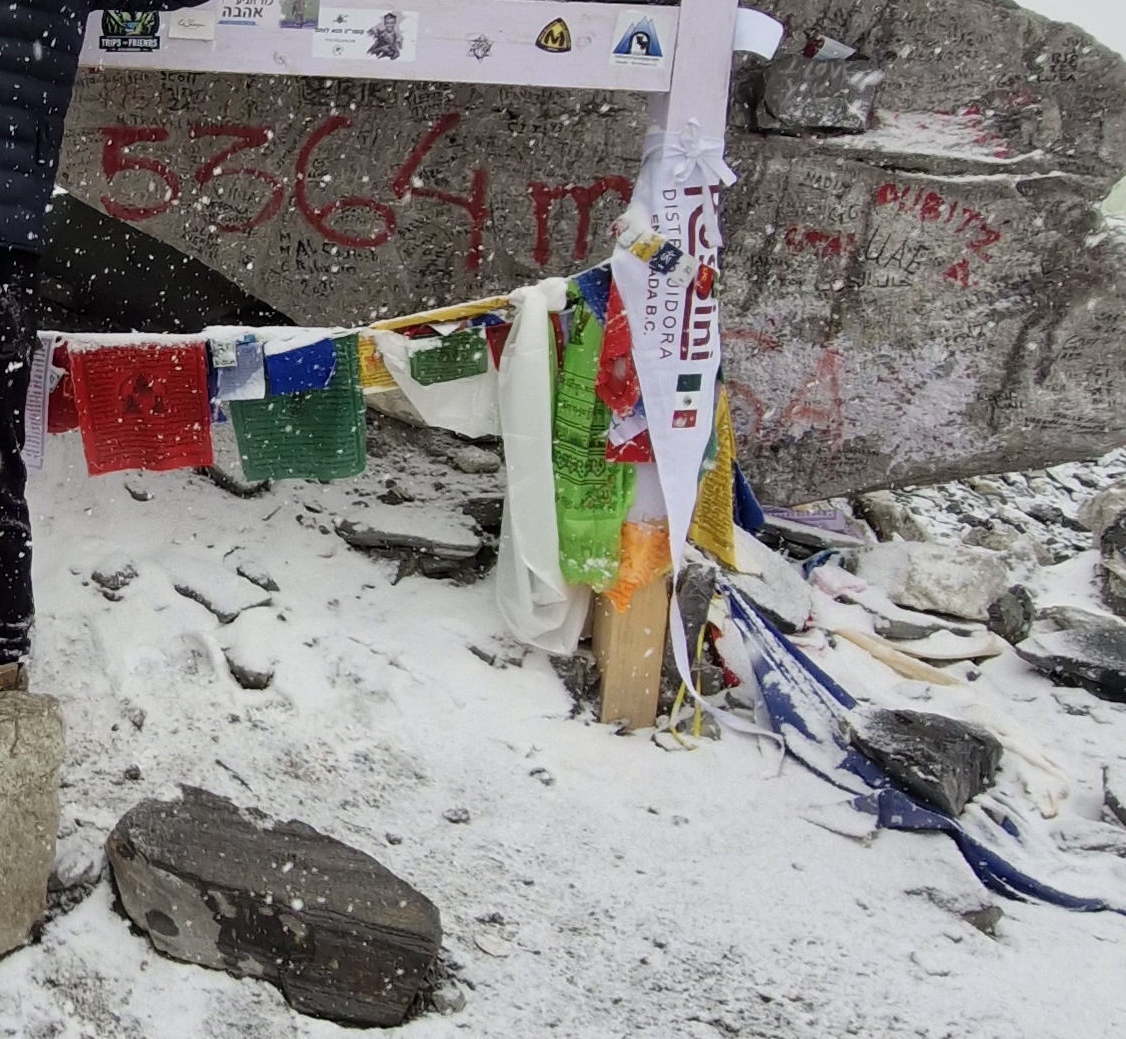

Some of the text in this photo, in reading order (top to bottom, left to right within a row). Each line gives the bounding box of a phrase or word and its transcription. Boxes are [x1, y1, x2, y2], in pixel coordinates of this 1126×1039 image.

[222, 6, 264, 18] אהבה
[98, 111, 490, 270] 5364
[865, 224, 930, 275] UAE
